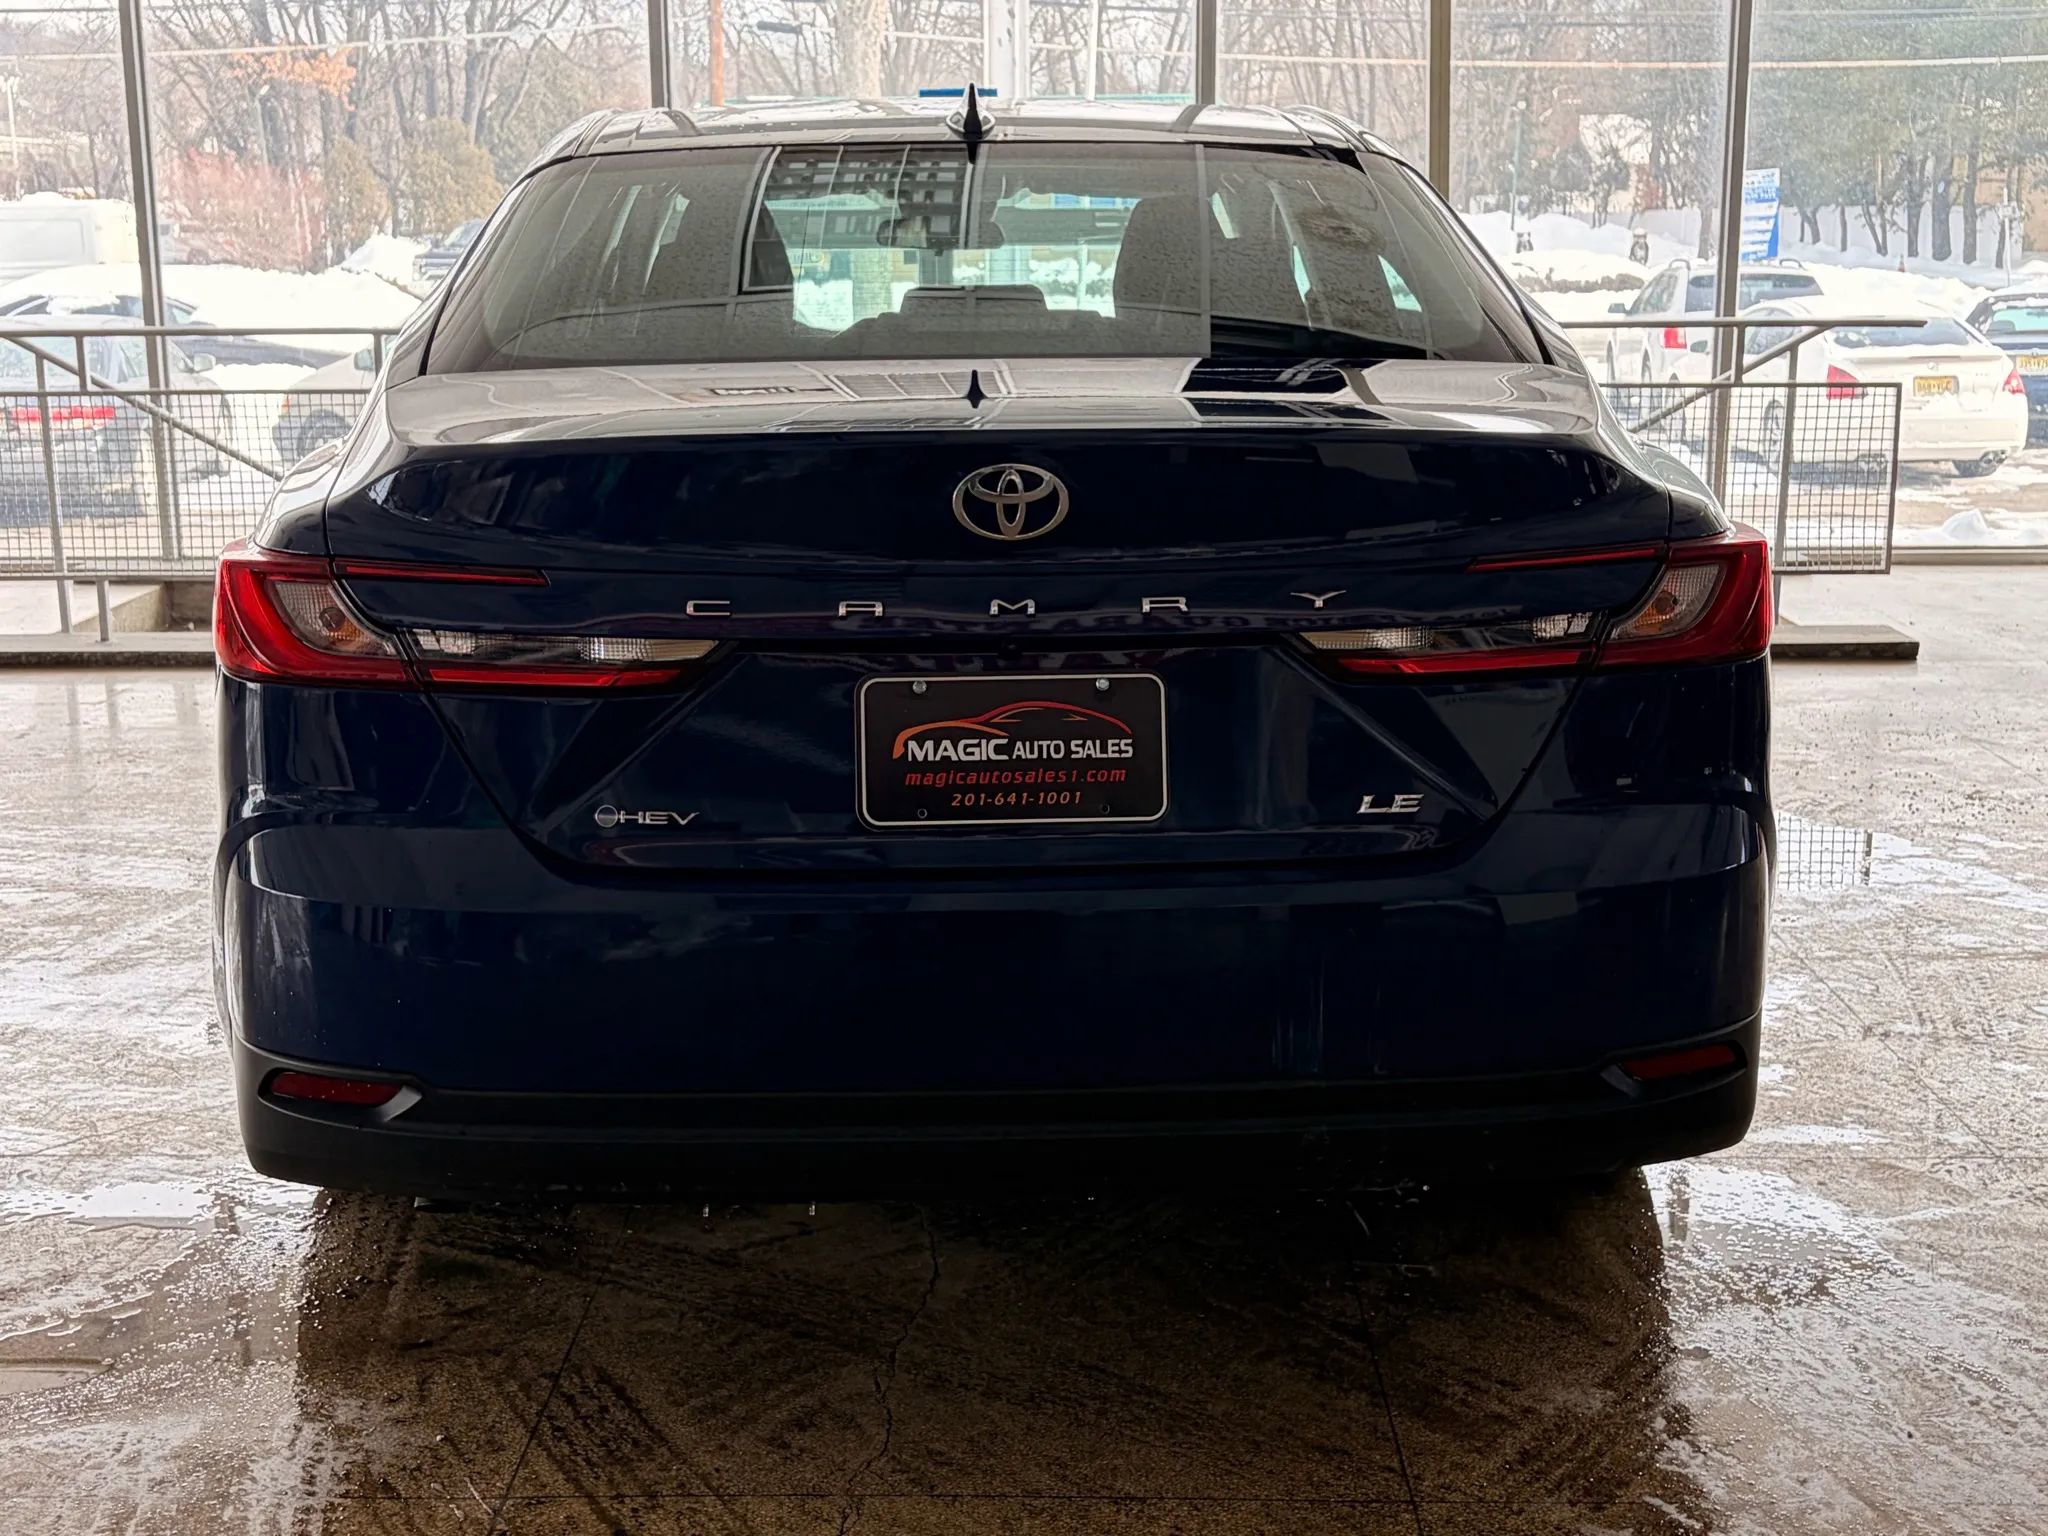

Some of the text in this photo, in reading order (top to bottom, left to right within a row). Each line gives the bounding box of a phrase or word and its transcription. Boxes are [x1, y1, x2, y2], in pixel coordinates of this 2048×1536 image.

[686, 590, 1346, 617] CAMRY
[907, 738, 1133, 761] MAGIC AUTO SALES
[905, 768, 1126, 788] magicautosales1.com
[951, 791, 1081, 806] 201-641-1001
[1356, 793, 1425, 814] LE
[619, 810, 700, 826] HEV
